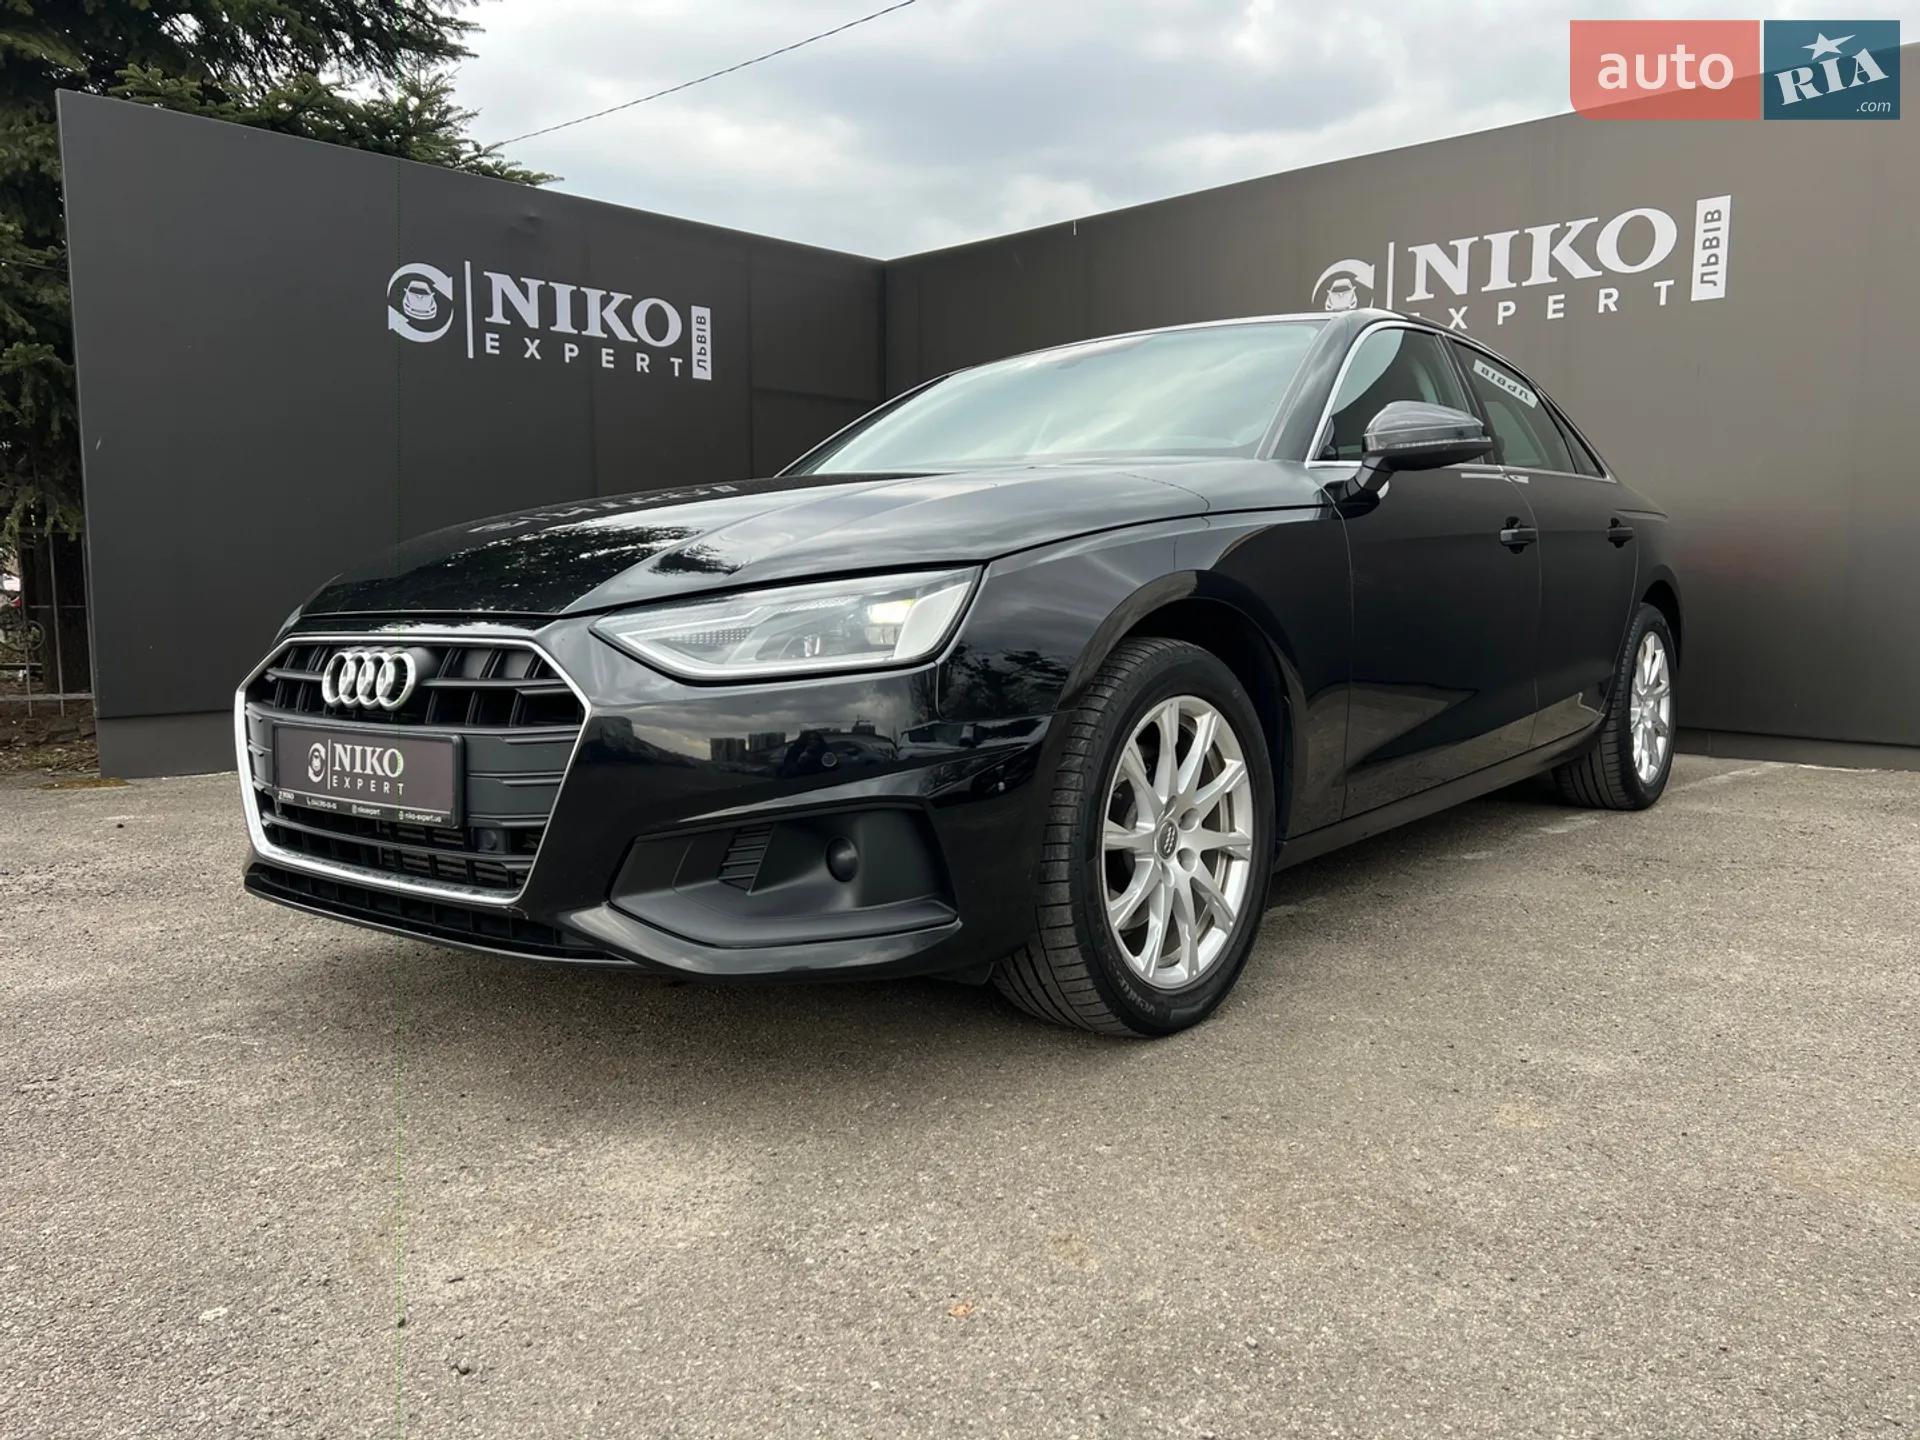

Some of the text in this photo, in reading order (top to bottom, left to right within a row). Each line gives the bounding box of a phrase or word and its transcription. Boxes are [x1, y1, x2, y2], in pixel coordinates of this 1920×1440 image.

[1406, 207, 1678, 302] NIKO
[1699, 207, 1724, 287] ЛЬВІВ
[483, 270, 683, 348] NIKO
[1410, 279, 1675, 330] XPERT
[484, 332, 683, 377] EXPERT
[332, 775, 404, 797] EXPERT
[333, 742, 404, 779] NIKO
